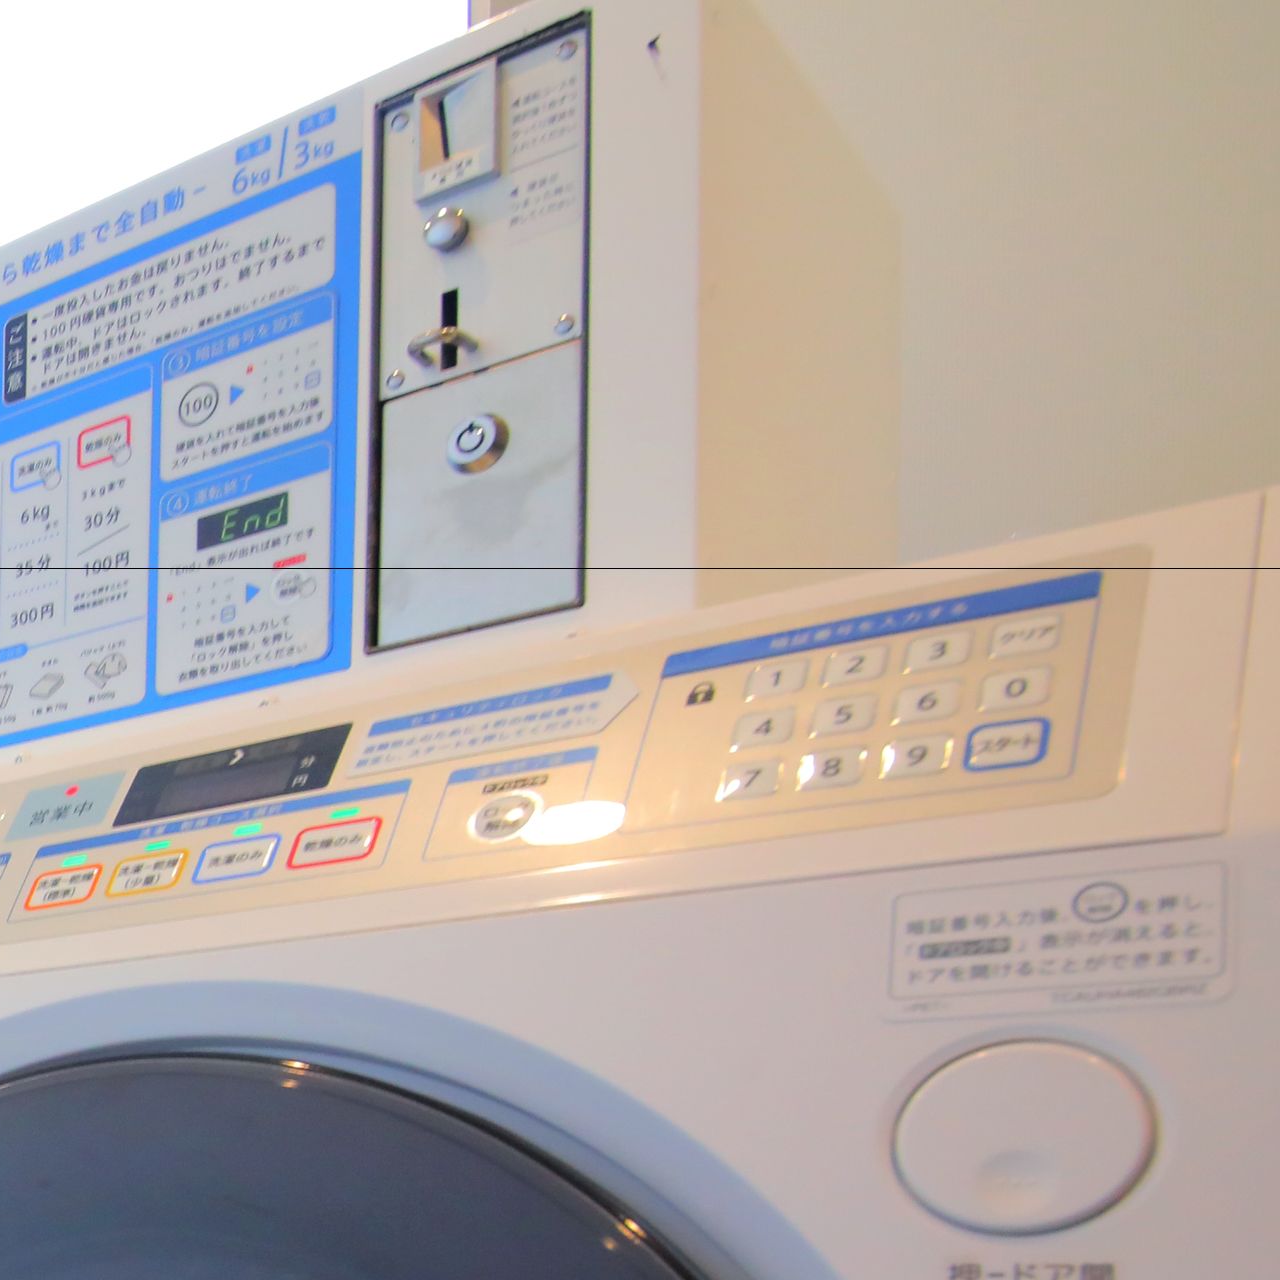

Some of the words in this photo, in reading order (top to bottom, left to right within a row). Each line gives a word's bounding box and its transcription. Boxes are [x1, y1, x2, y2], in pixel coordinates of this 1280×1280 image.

[232, 167, 271, 195] 6kg
[294, 139, 336, 170] 3kg
[184, 394, 213, 416] 100
[20, 504, 51, 525] 6kg
[83, 506, 121, 532] 30分
[220, 497, 285, 542] End
[83, 550, 131, 577] 100円
[9, 602, 55, 629] 300円
[928, 640, 948, 661] 3
[846, 656, 866, 675] 2
[770, 669, 783, 688] 1
[1004, 677, 1028, 699] 0
[917, 691, 938, 712] 6
[835, 704, 855, 724] 5
[753, 717, 775, 737] 4
[298, 754, 316, 771] 分
[906, 744, 929, 767] 9
[741, 768, 763, 789] 7
[820, 757, 842, 780] 8
[290, 774, 308, 789] 円
[28, 800, 95, 828] 営業中
